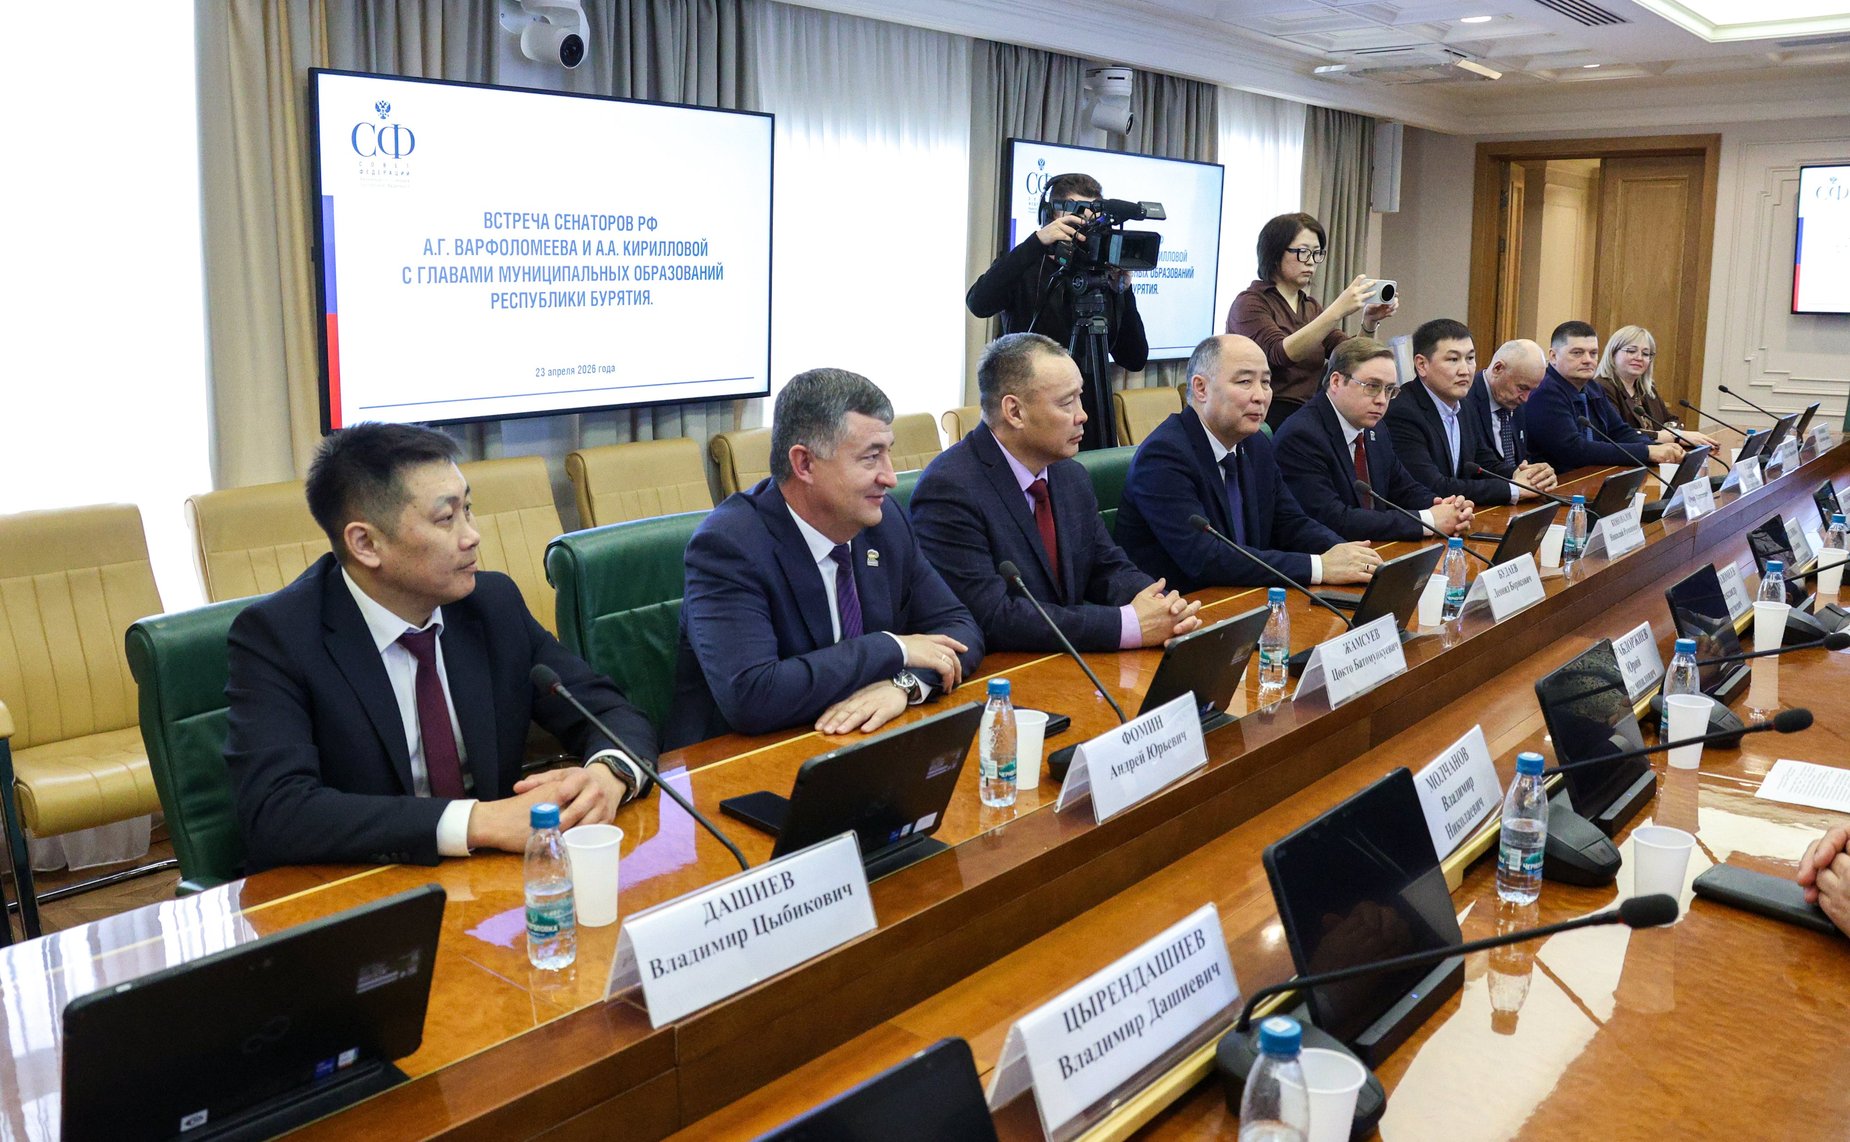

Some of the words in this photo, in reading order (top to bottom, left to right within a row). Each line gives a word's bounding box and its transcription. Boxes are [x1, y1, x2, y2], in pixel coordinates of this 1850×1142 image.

[351, 122, 415, 159] СФ
[483, 211, 550, 230] ВСТРЕЧА
[554, 213, 634, 231] СЕНАТОРОВ
[638, 215, 658, 231] РФ
[423, 238, 450, 256] А.Г.
[454, 238, 578, 256] ВАРФОЛОМЕЕВА
[582, 239, 592, 256] И
[595, 239, 619, 256] А.А.
[623, 237, 708, 257] КИРИЛЛОВОЙ
[1158, 249, 1188, 262] ИЛЛОВОЙ
[402, 266, 412, 284] С
[417, 266, 494, 284] ГЛАВАМИ
[499, 265, 630, 285] МУНИЦИПАЛЬНЫХ
[633, 261, 724, 281] ОБРАЗОВАНИЙ
[1150, 266, 1194, 279] ОБРАЗОВАНИЙ
[491, 290, 586, 309] РЕСПУБЛИКИ
[590, 289, 653, 307] БУРЯТИЯ.
[1133, 283, 1159, 295] УРЯТИЯ.
[535, 367, 546, 378] 23
[547, 367, 576, 379] апреля
[577, 363, 597, 375] 2026
[598, 364, 616, 375] года
[1342, 628, 1381, 655] ЖАМСУЕВ
[1331, 665, 1354, 682] Цокто
[1121, 714, 1164, 746] ФОМИН
[1109, 750, 1146, 780] Андрей
[1146, 730, 1188, 761] Юрьевич
[1425, 746, 1470, 794] МОЛЧАНОВ
[1440, 776, 1475, 812] Владимир
[1444, 796, 1485, 841] Николаевич
[703, 870, 795, 926] ДАШИЕВ
[649, 927, 749, 980] Владимир
[751, 883, 854, 937] Цыбикович
[1062, 928, 1206, 1035] ЦЫРЕНДАШИЕВ
[1057, 1013, 1145, 1081] Владимир
[1148, 961, 1222, 1026] Дашиевич
